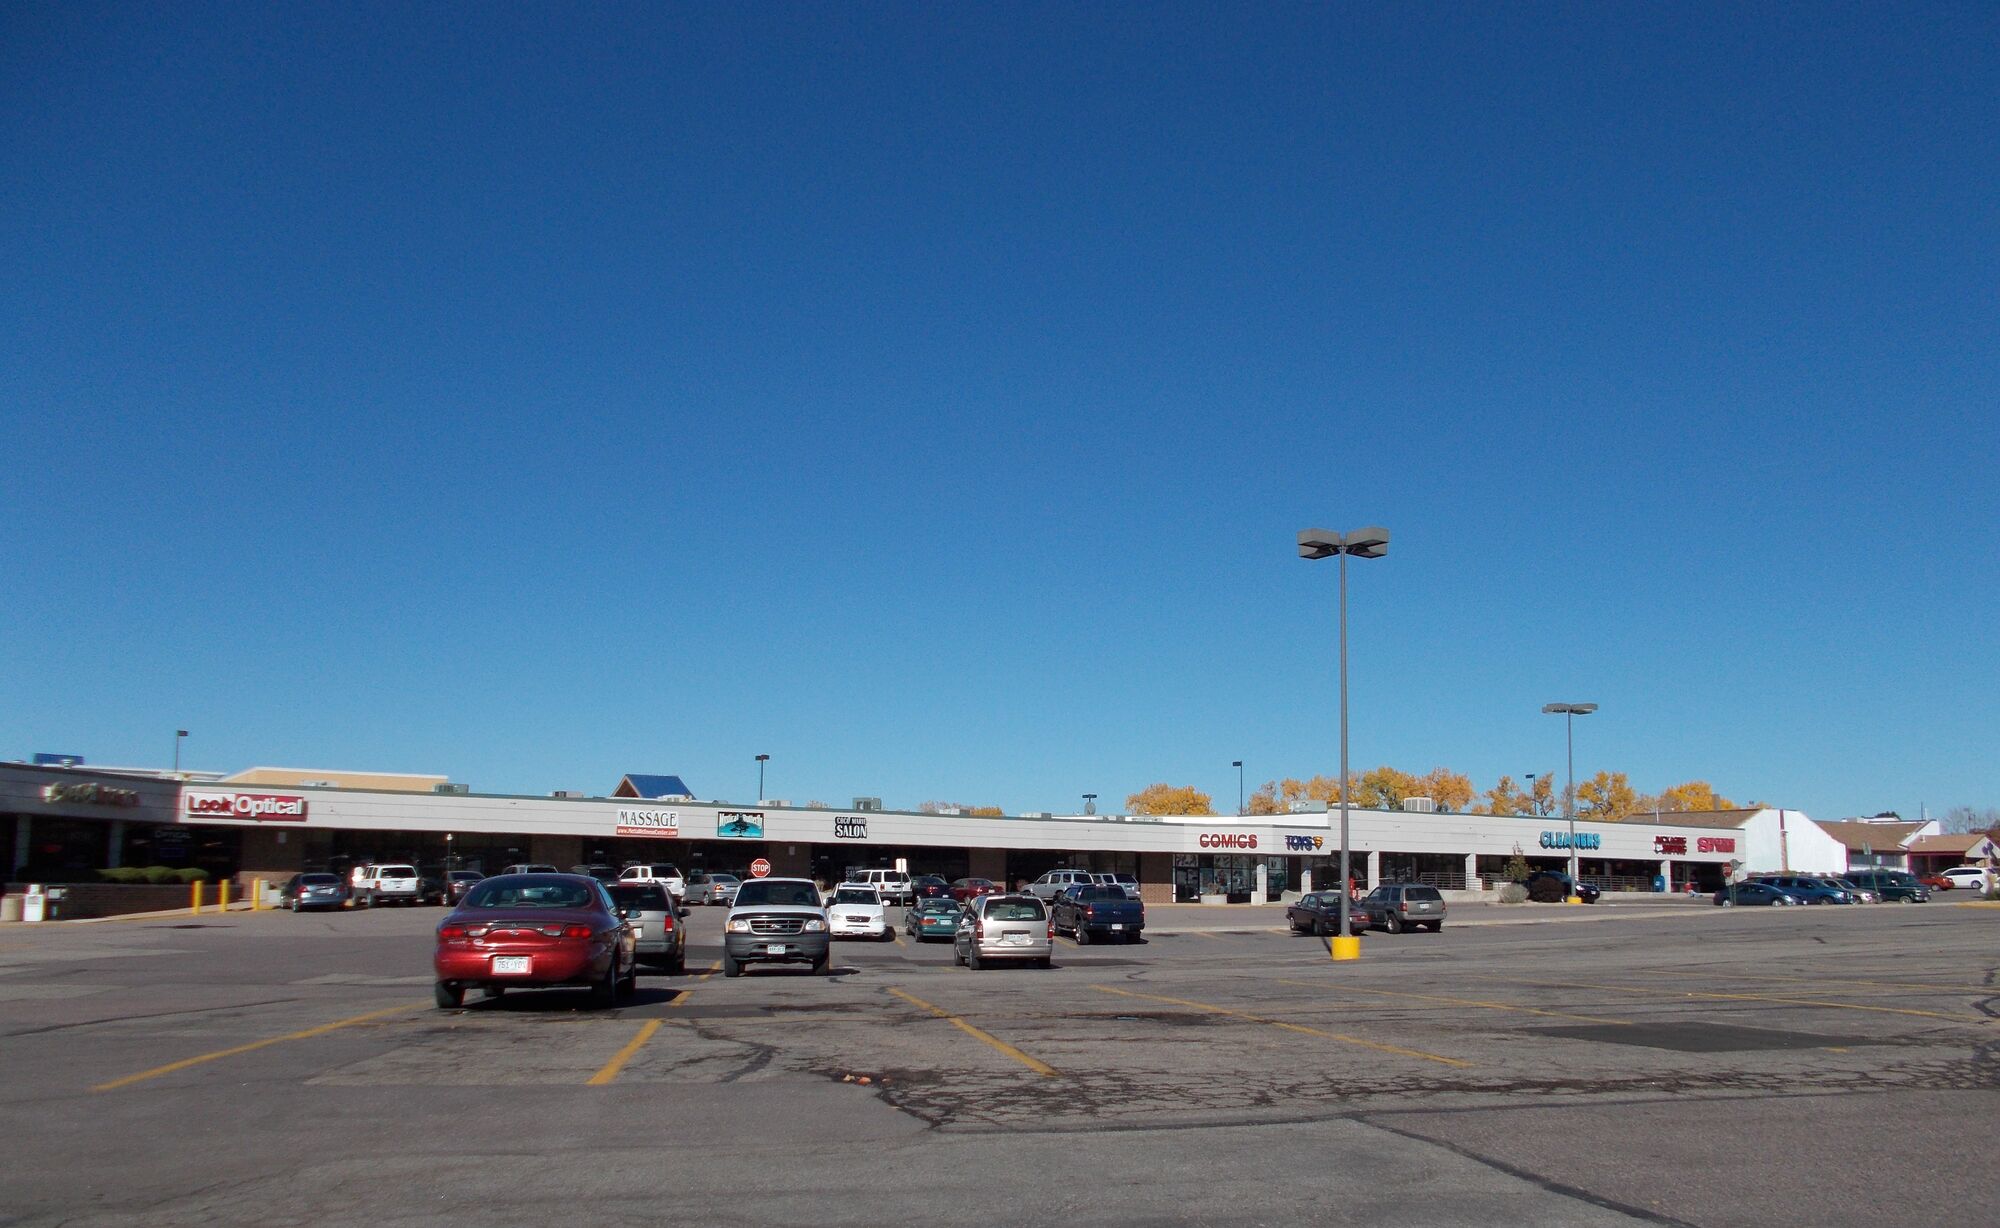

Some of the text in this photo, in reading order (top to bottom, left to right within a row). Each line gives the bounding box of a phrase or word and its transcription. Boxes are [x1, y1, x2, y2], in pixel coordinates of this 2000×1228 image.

[188, 795, 303, 817] Look Optical
[618, 811, 677, 827] MASSAGE
[836, 824, 867, 838] SALON
[1199, 833, 1258, 849] COMICS
[1285, 835, 1313, 851] TOYS
[1539, 831, 1600, 850] CLEANERS
[752, 864, 769, 872] STOP
